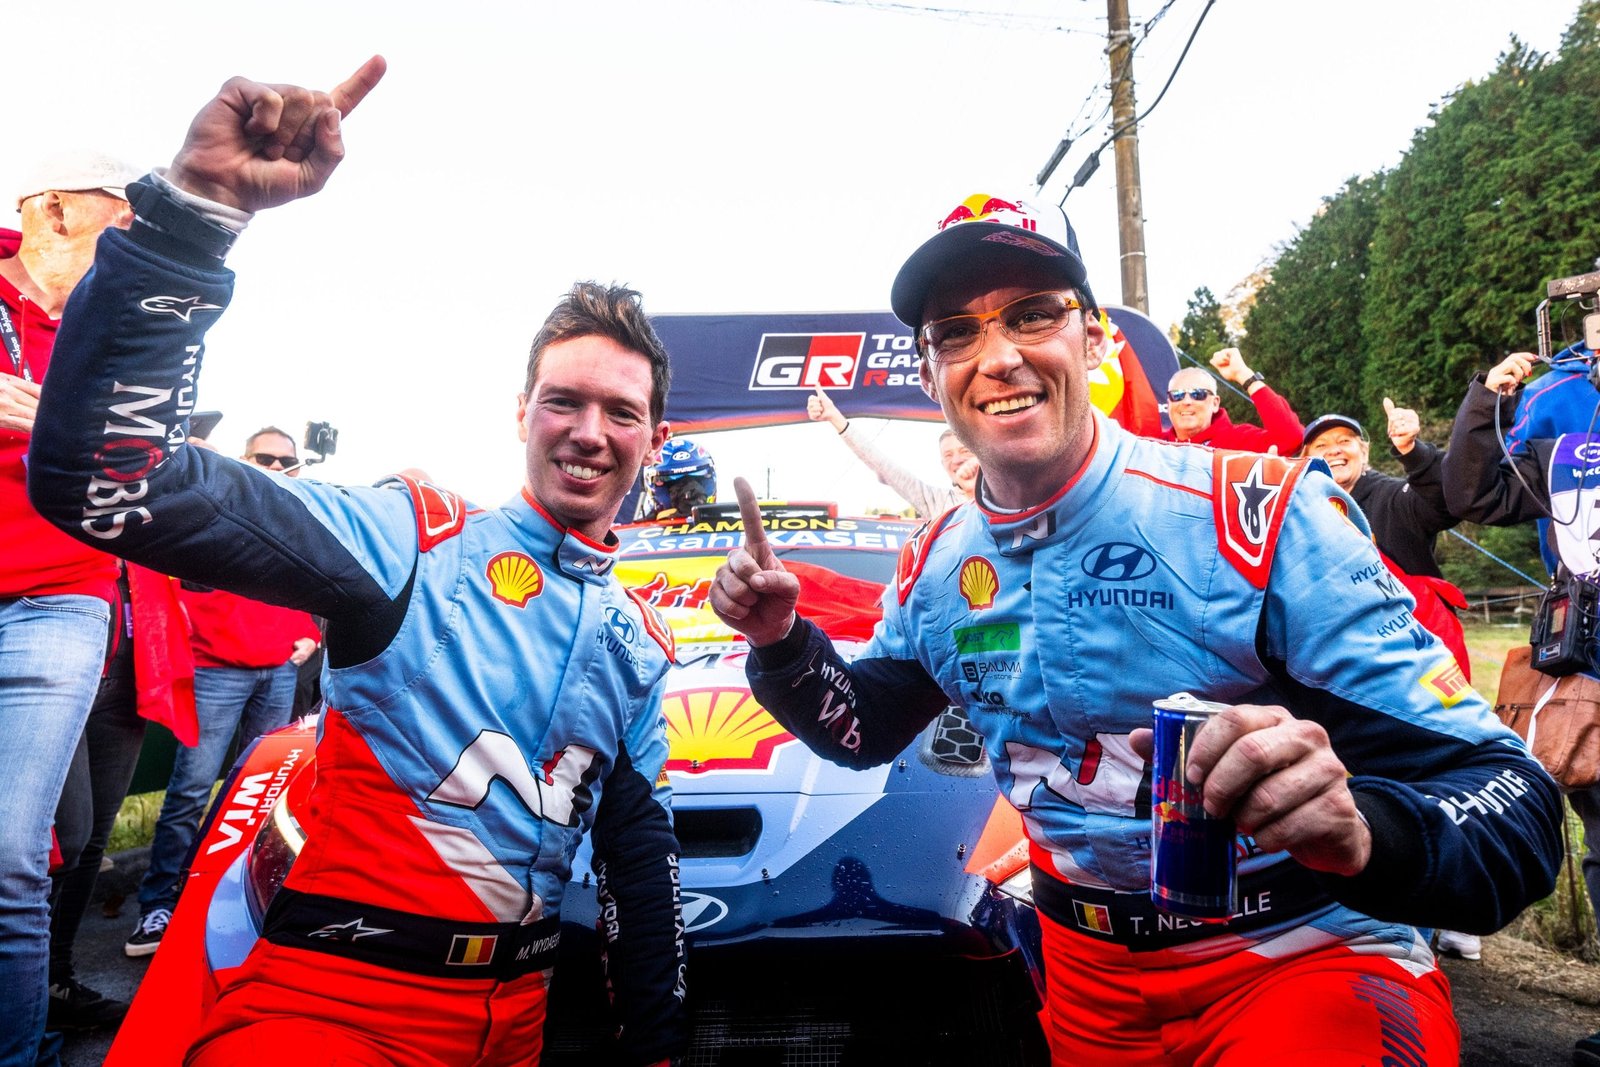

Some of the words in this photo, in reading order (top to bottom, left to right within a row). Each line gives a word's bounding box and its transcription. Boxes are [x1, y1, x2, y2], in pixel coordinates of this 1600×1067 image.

[757, 355, 854, 386] GR
[81, 380, 175, 540] MOBIS
[1067, 588, 1175, 611] HYUNDAI
[978, 660, 1022, 674] BAUMA
[257, 749, 304, 814] HYUNDAI
[1130, 916, 1150, 936] T.
